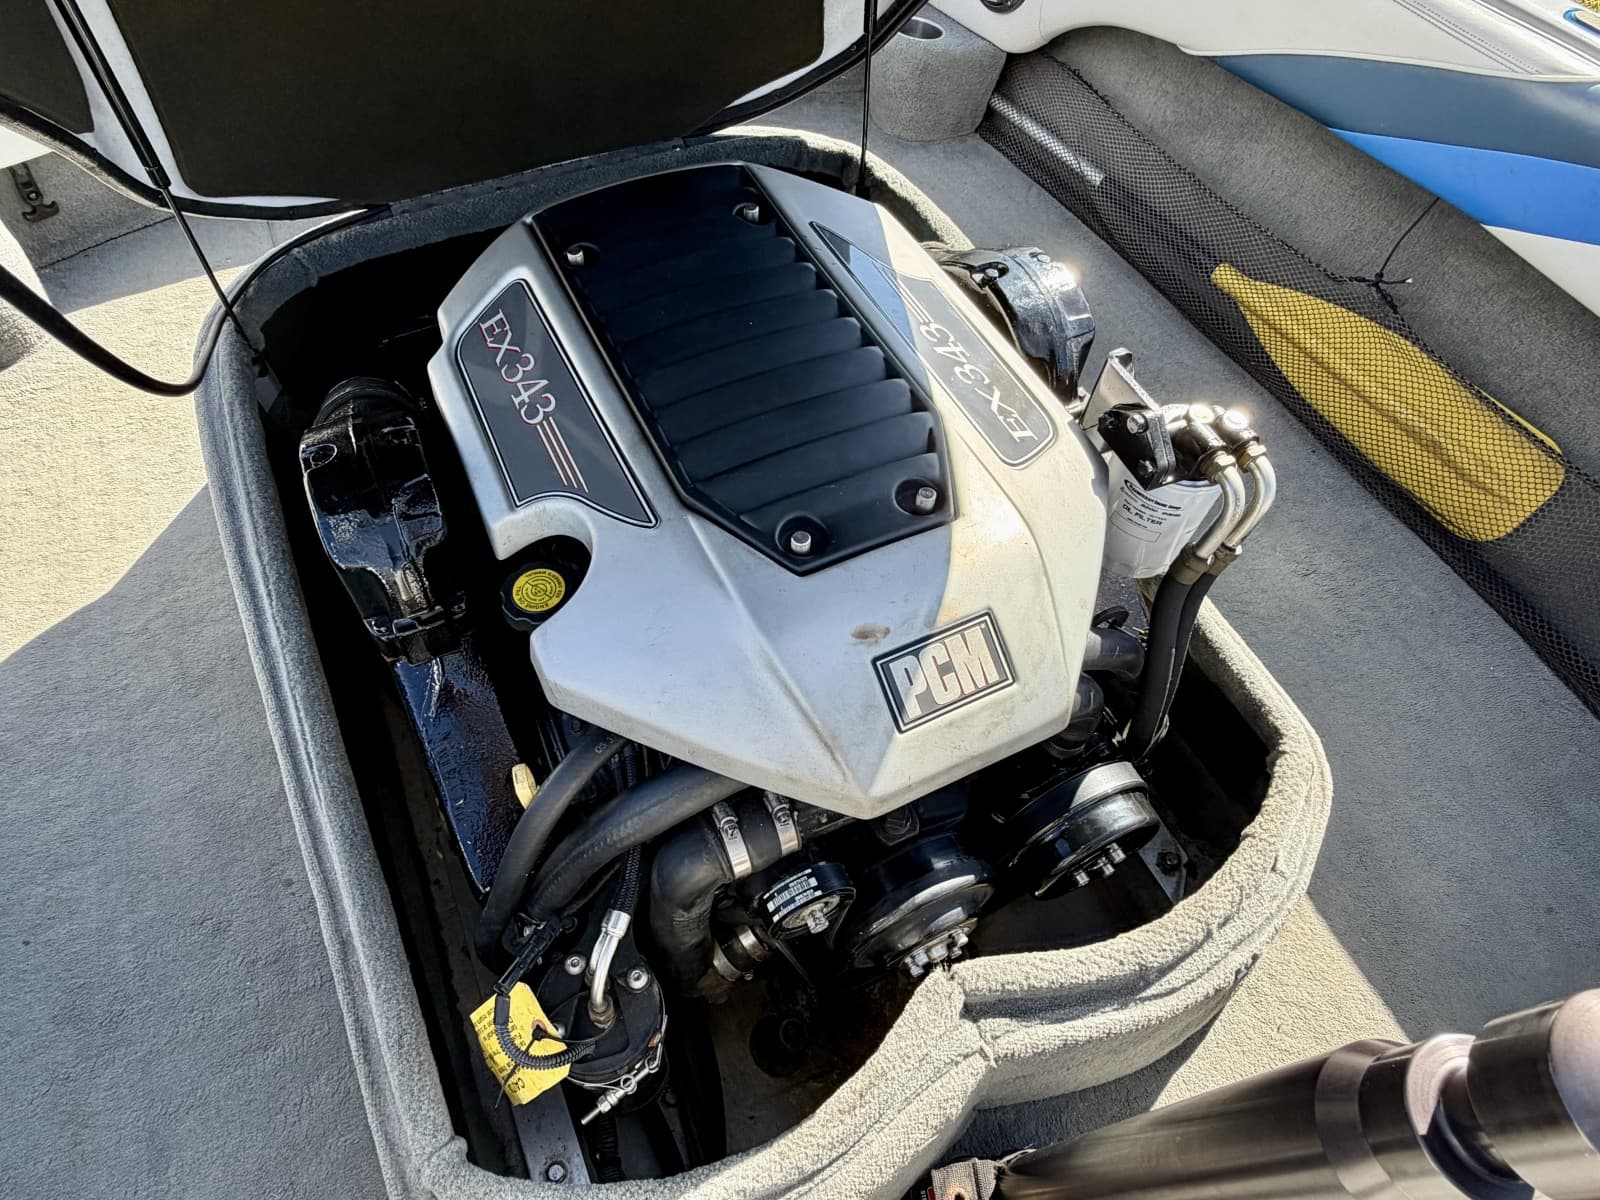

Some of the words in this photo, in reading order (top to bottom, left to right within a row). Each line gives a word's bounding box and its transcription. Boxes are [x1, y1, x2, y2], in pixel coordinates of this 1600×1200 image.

[480, 309, 556, 425] EX343
[920, 322, 1038, 442] EX343
[1135, 511, 1162, 525] FILTER
[889, 626, 1000, 719] PCM
